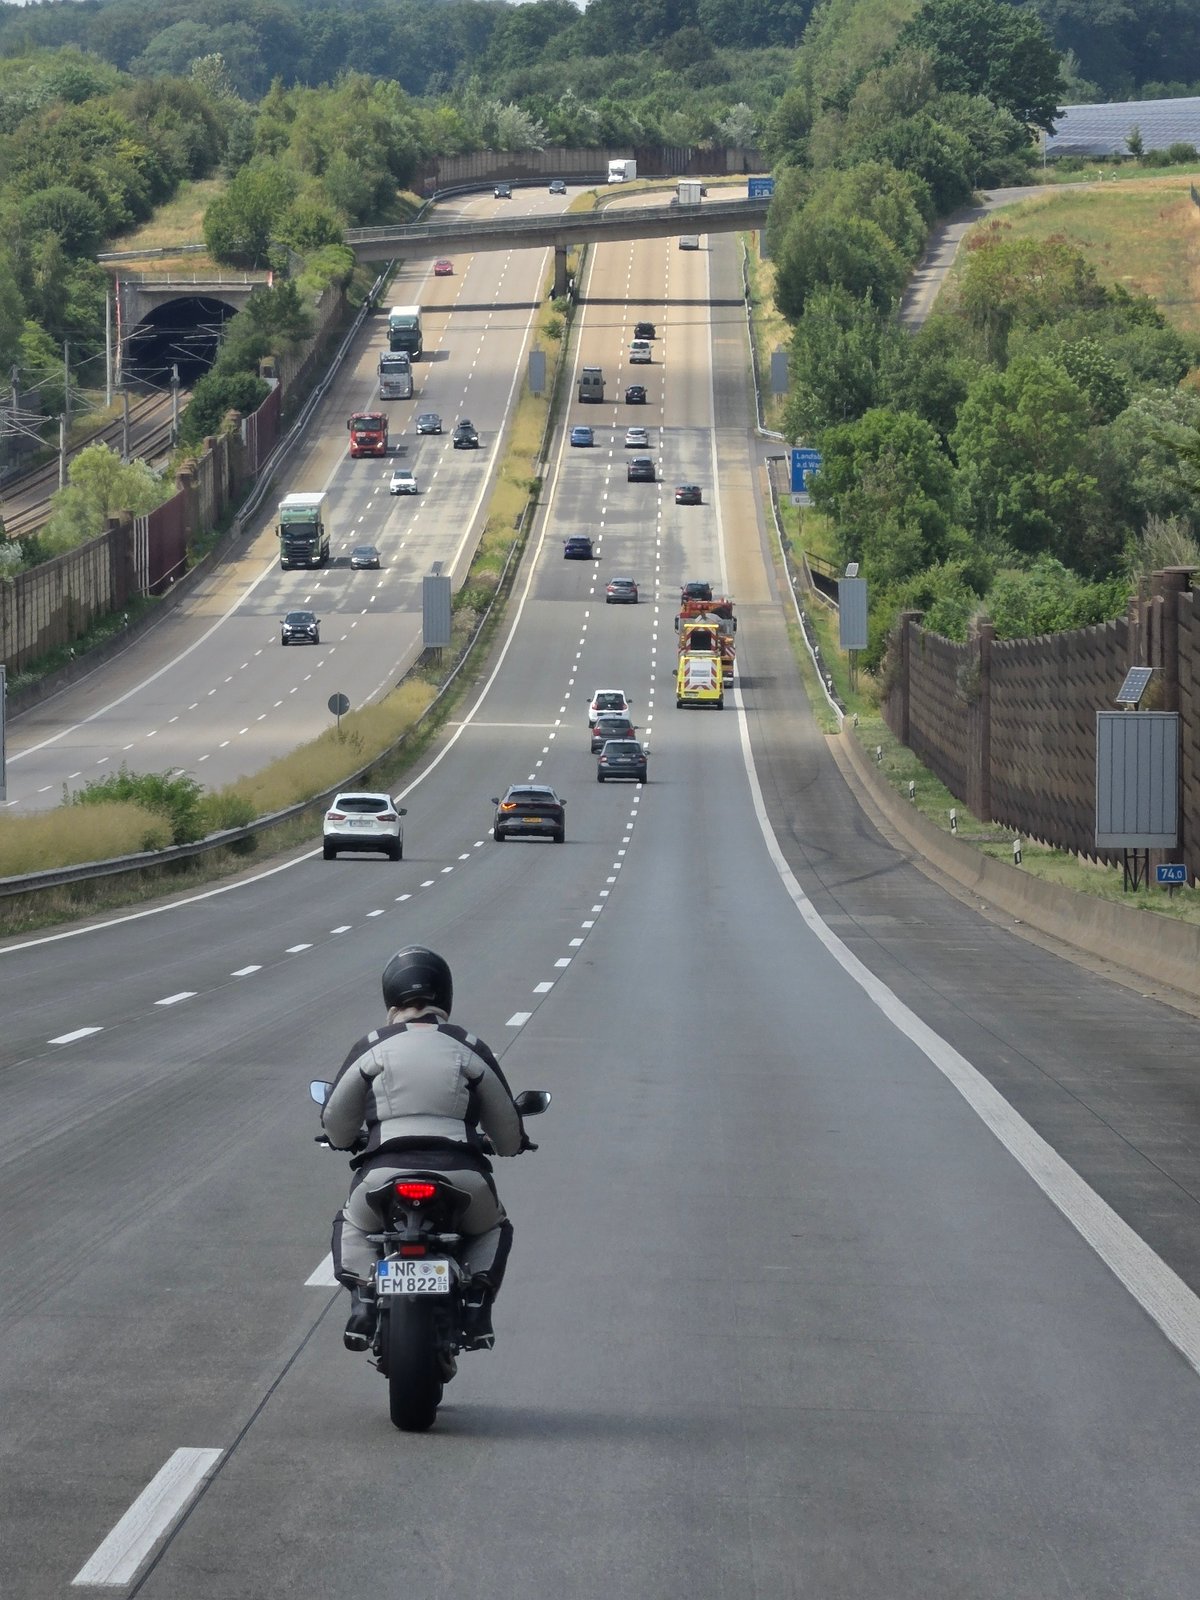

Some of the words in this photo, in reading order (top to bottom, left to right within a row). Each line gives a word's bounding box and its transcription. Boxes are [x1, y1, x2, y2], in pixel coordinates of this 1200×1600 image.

[1161, 868, 1183, 879] 74.0
[395, 1262, 416, 1276] NR
[381, 1278, 403, 1292] FM
[407, 1277, 437, 1292] 822
